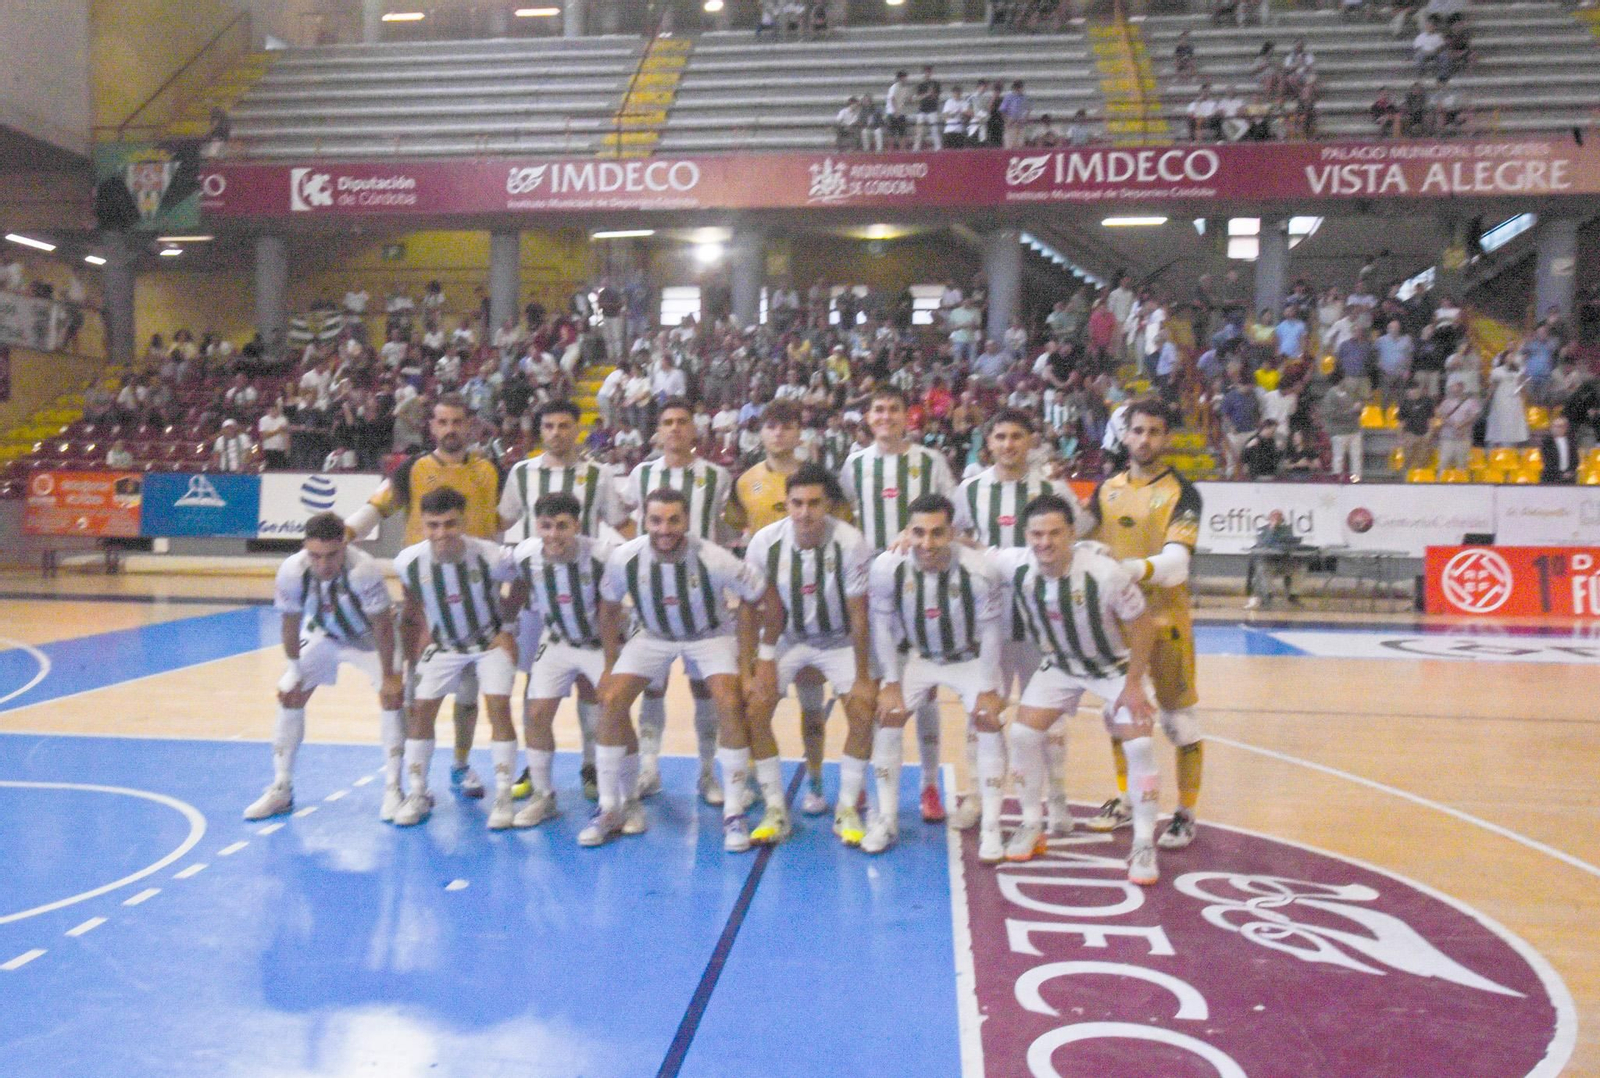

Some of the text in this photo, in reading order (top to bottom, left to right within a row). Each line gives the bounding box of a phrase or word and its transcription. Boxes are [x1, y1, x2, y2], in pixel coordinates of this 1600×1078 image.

[551, 161, 699, 193] IMDECO
[1054, 149, 1219, 184] IMDECO
[1305, 159, 1572, 194] VISTA ALEGRE
[1209, 507, 1313, 533] efficld
